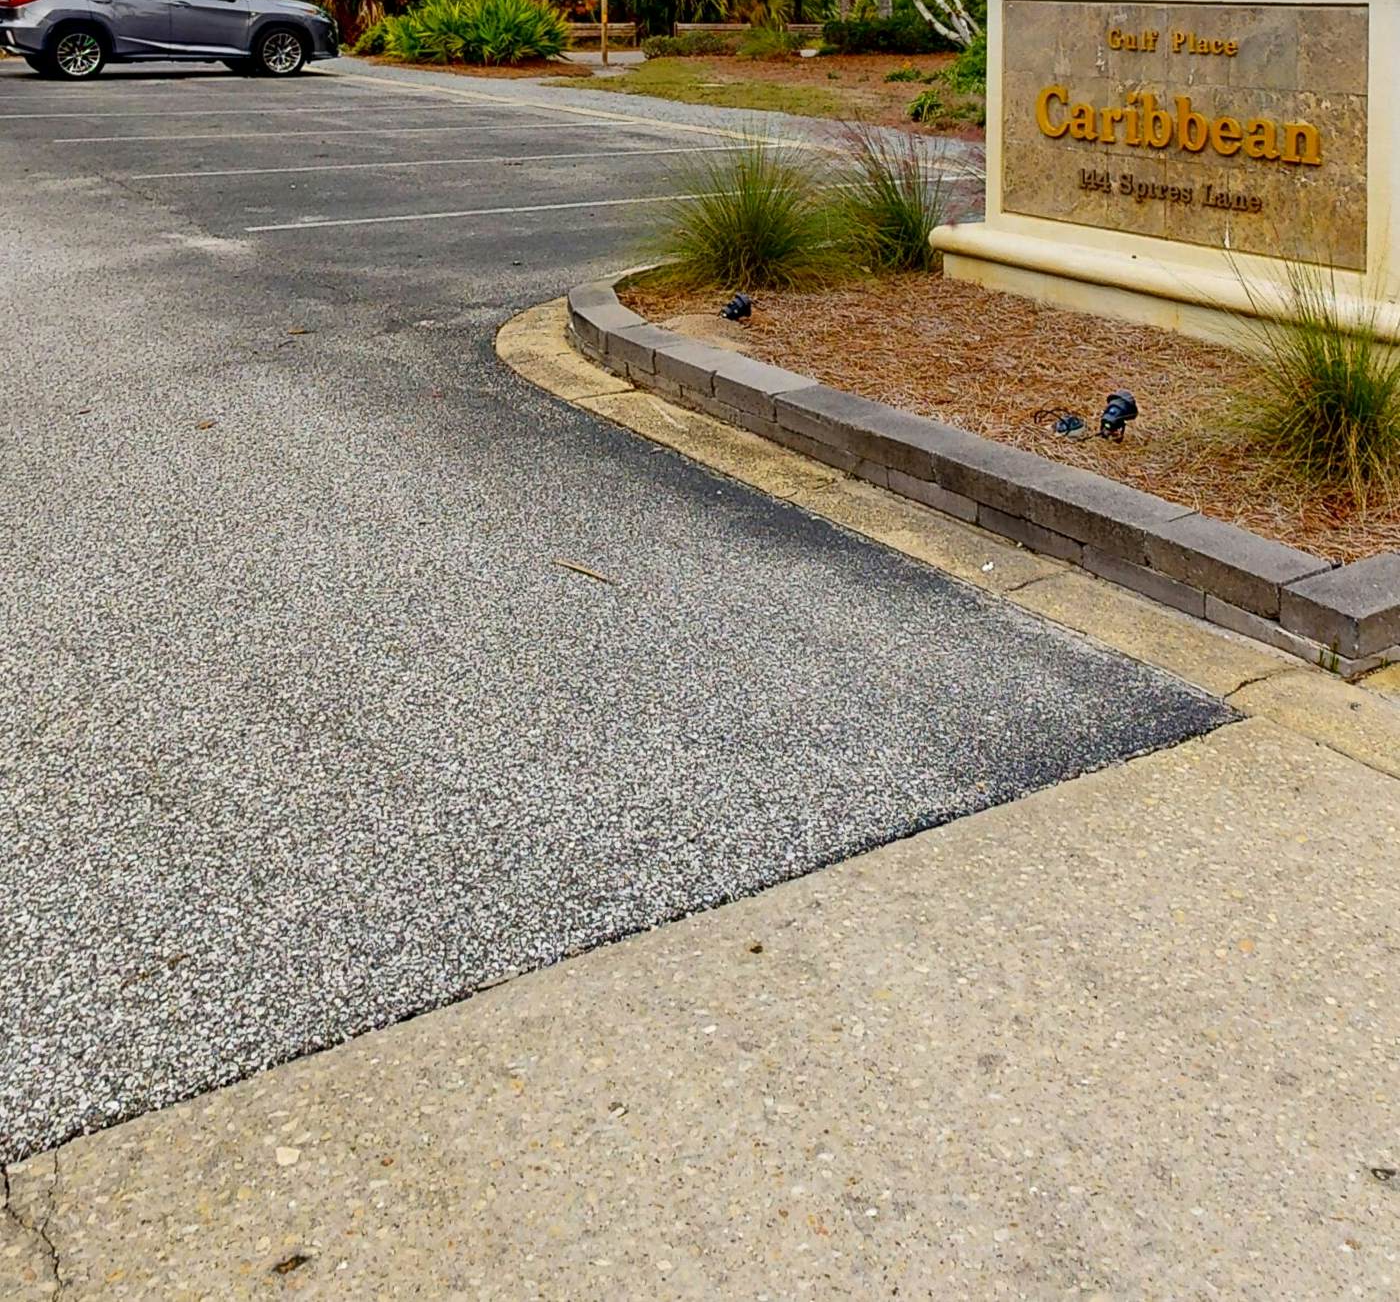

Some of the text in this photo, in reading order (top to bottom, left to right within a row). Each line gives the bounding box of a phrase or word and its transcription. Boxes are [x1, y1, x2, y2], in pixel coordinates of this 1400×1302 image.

[1107, 26, 1239, 57] Gulf Place
[1034, 84, 1323, 166] Caribbean
[1078, 168, 1263, 214] 144 Spires Lane
